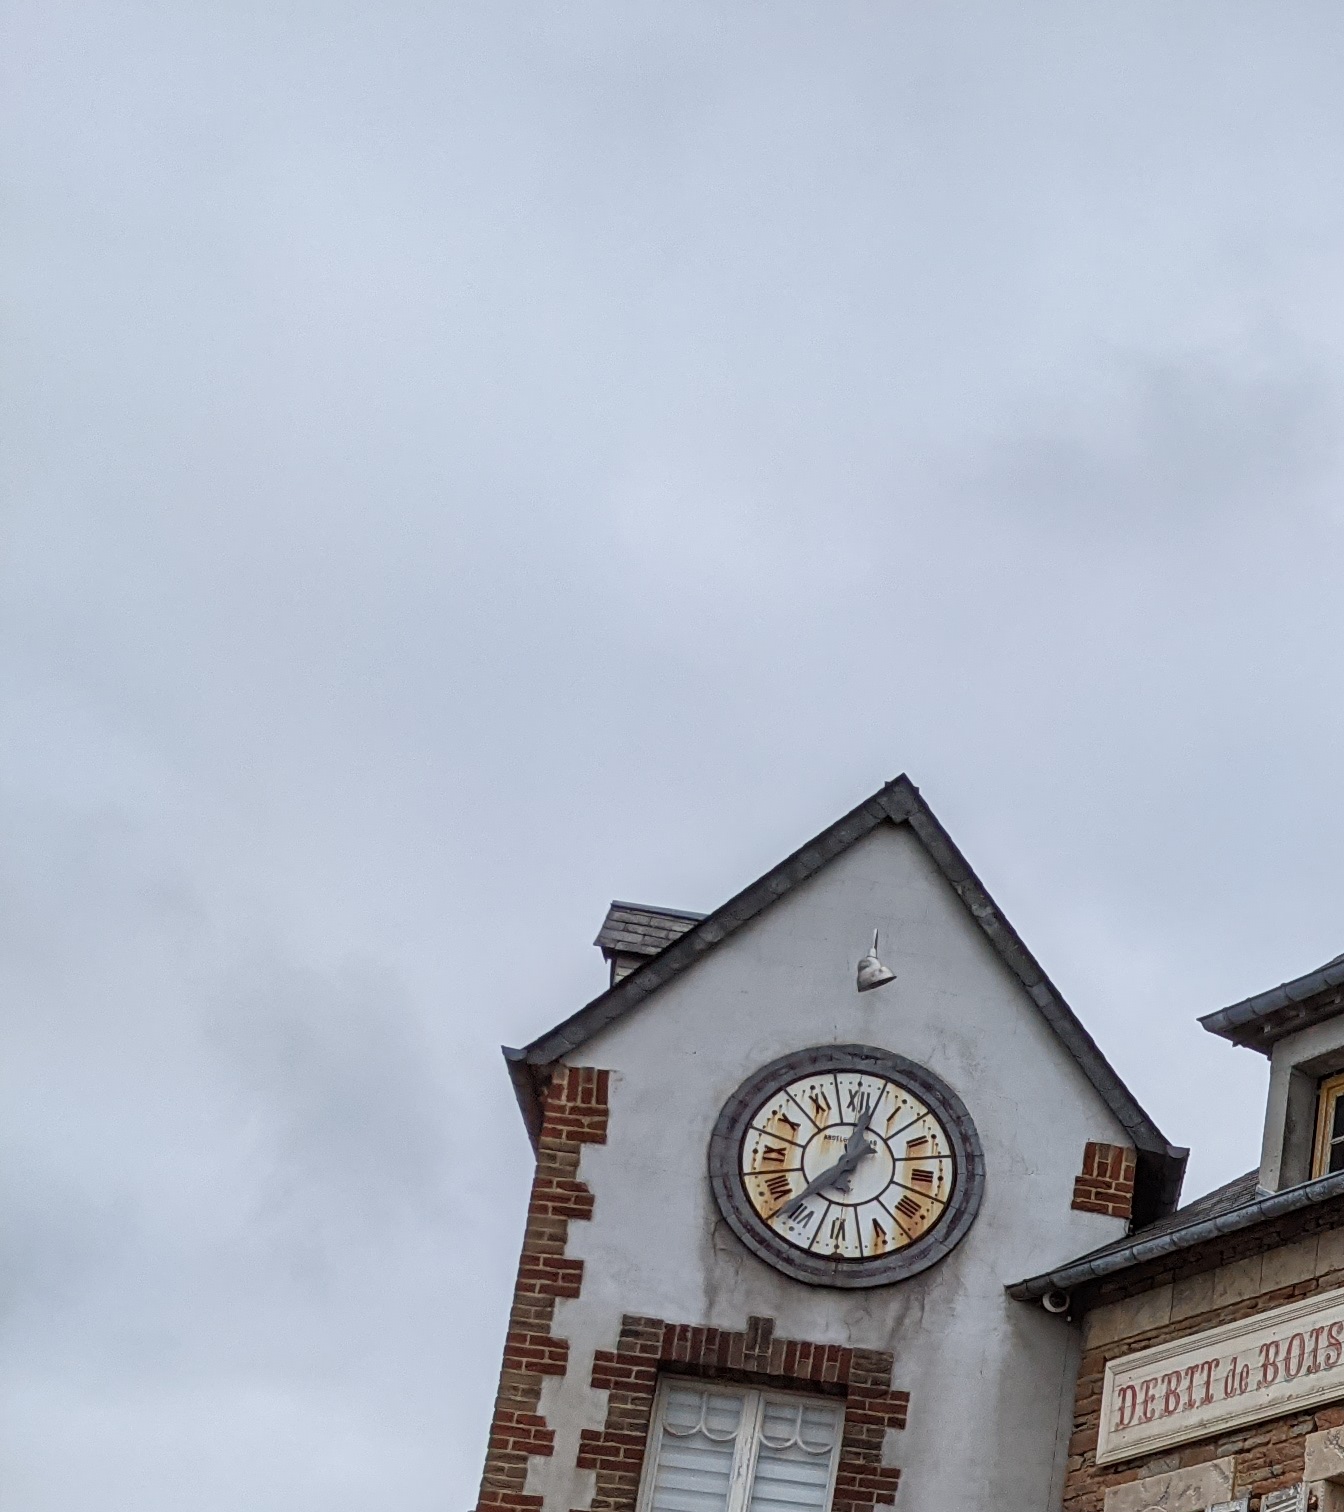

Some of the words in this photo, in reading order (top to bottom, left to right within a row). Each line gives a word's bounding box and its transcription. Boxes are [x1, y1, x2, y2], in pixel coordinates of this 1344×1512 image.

[808, 1090, 833, 1115] XI
[777, 1112, 802, 1132] X
[1114, 1357, 1220, 1429] DEBIT
[1223, 1356, 1250, 1399] de
